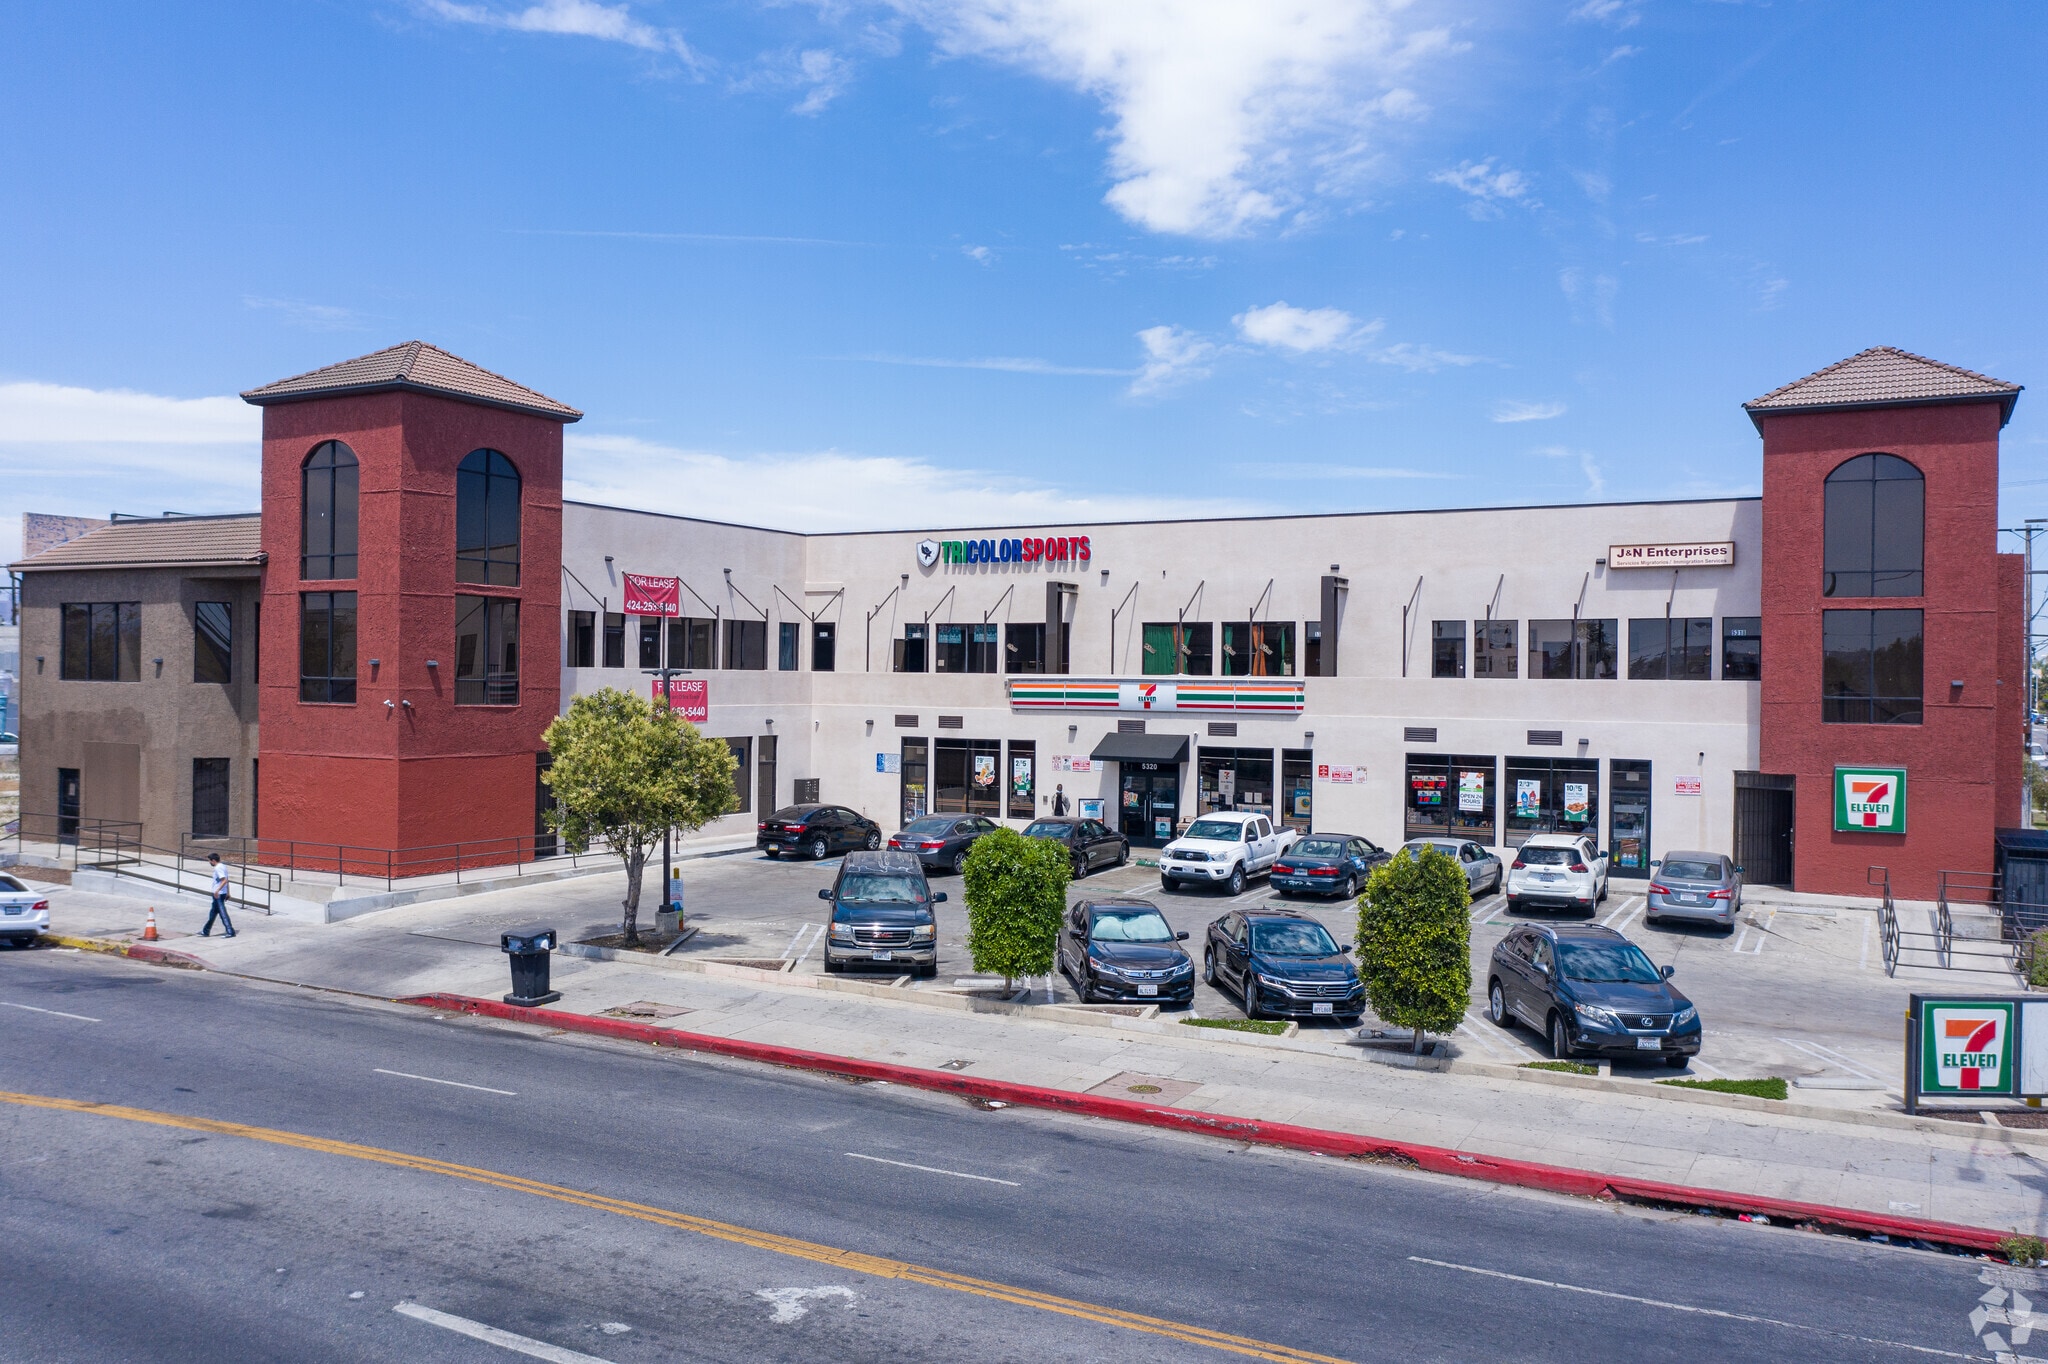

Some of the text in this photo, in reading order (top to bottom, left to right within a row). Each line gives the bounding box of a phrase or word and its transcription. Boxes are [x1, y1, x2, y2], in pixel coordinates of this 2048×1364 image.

[942, 535, 1091, 564] TRICOLORSPORTS
[1617, 546, 1728, 558] J&N Enterprises
[629, 576, 675, 589] FOR LEASE
[657, 681, 703, 692] FR LEASE
[1852, 782, 1888, 826] 7
[1945, 1019, 1996, 1089] 7
